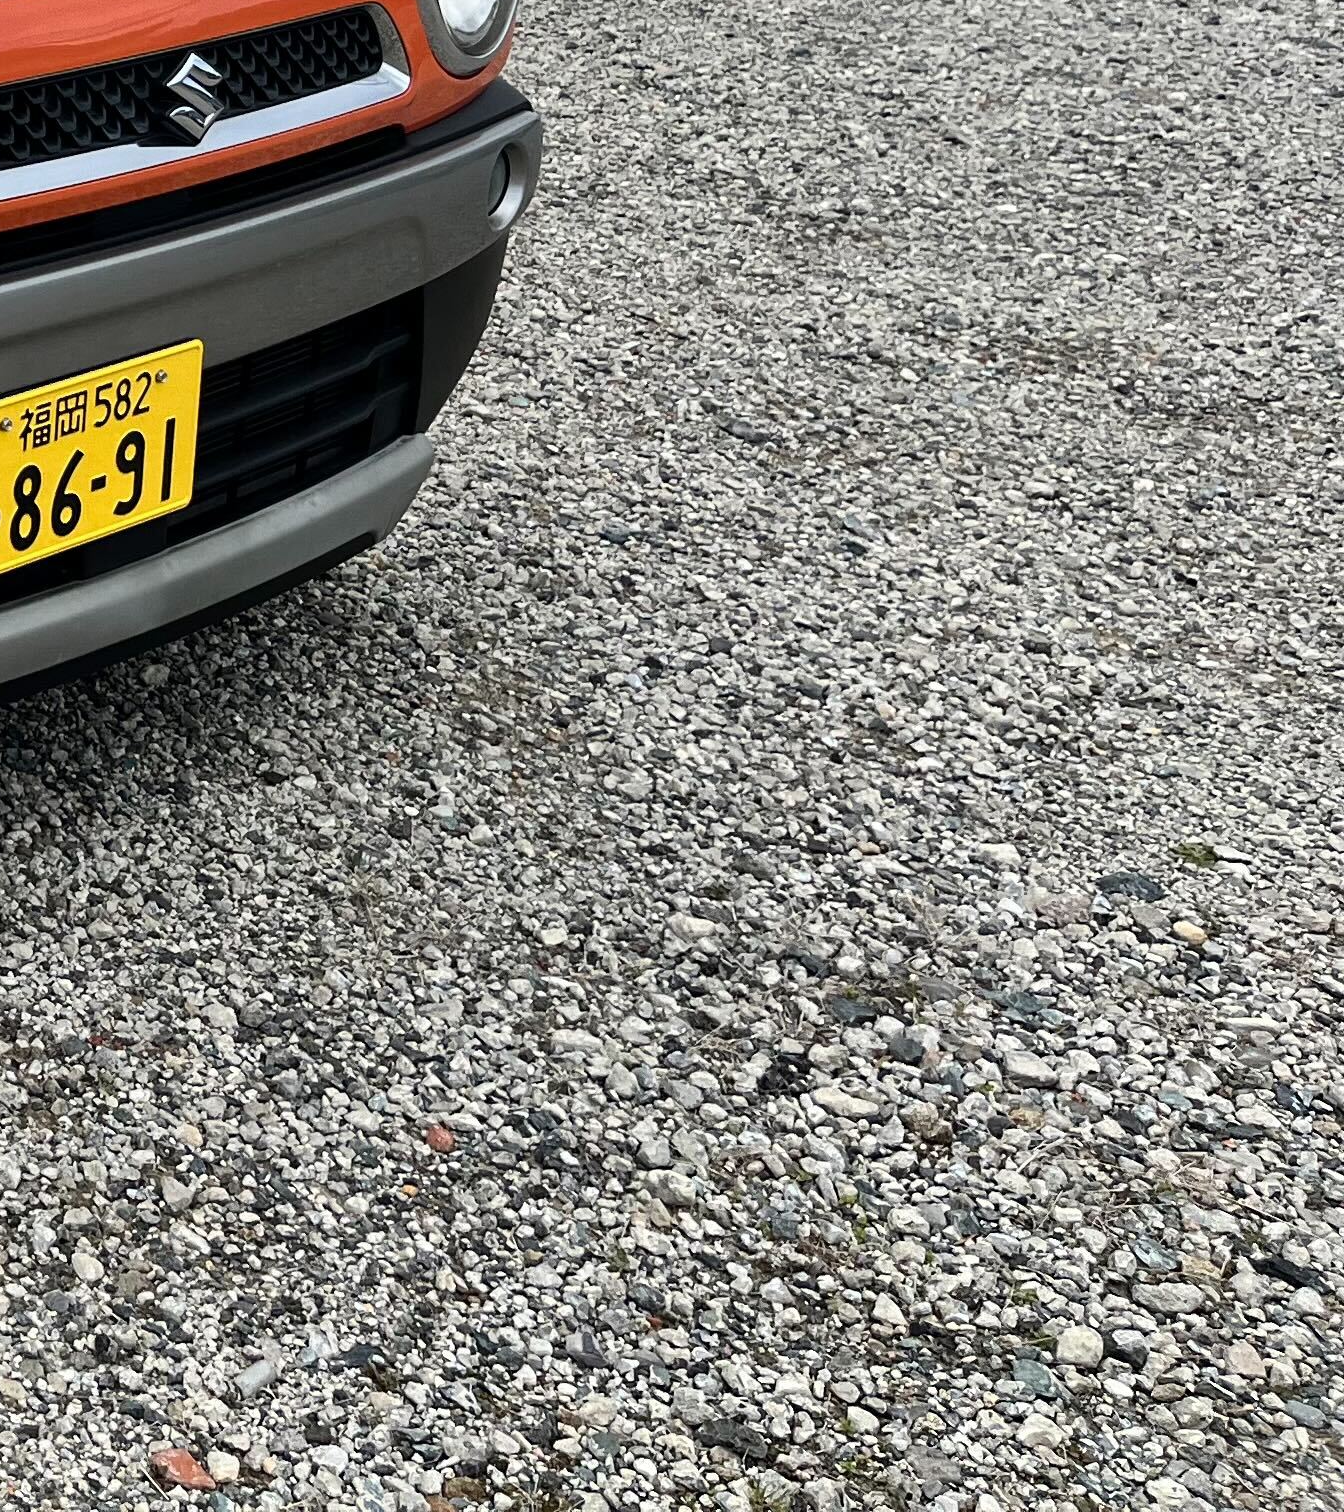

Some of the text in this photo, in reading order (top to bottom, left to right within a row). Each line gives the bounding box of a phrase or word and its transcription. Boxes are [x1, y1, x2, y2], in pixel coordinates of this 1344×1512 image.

[19, 371, 152, 452] 福岡 582
[9, 417, 176, 552] 86-91
